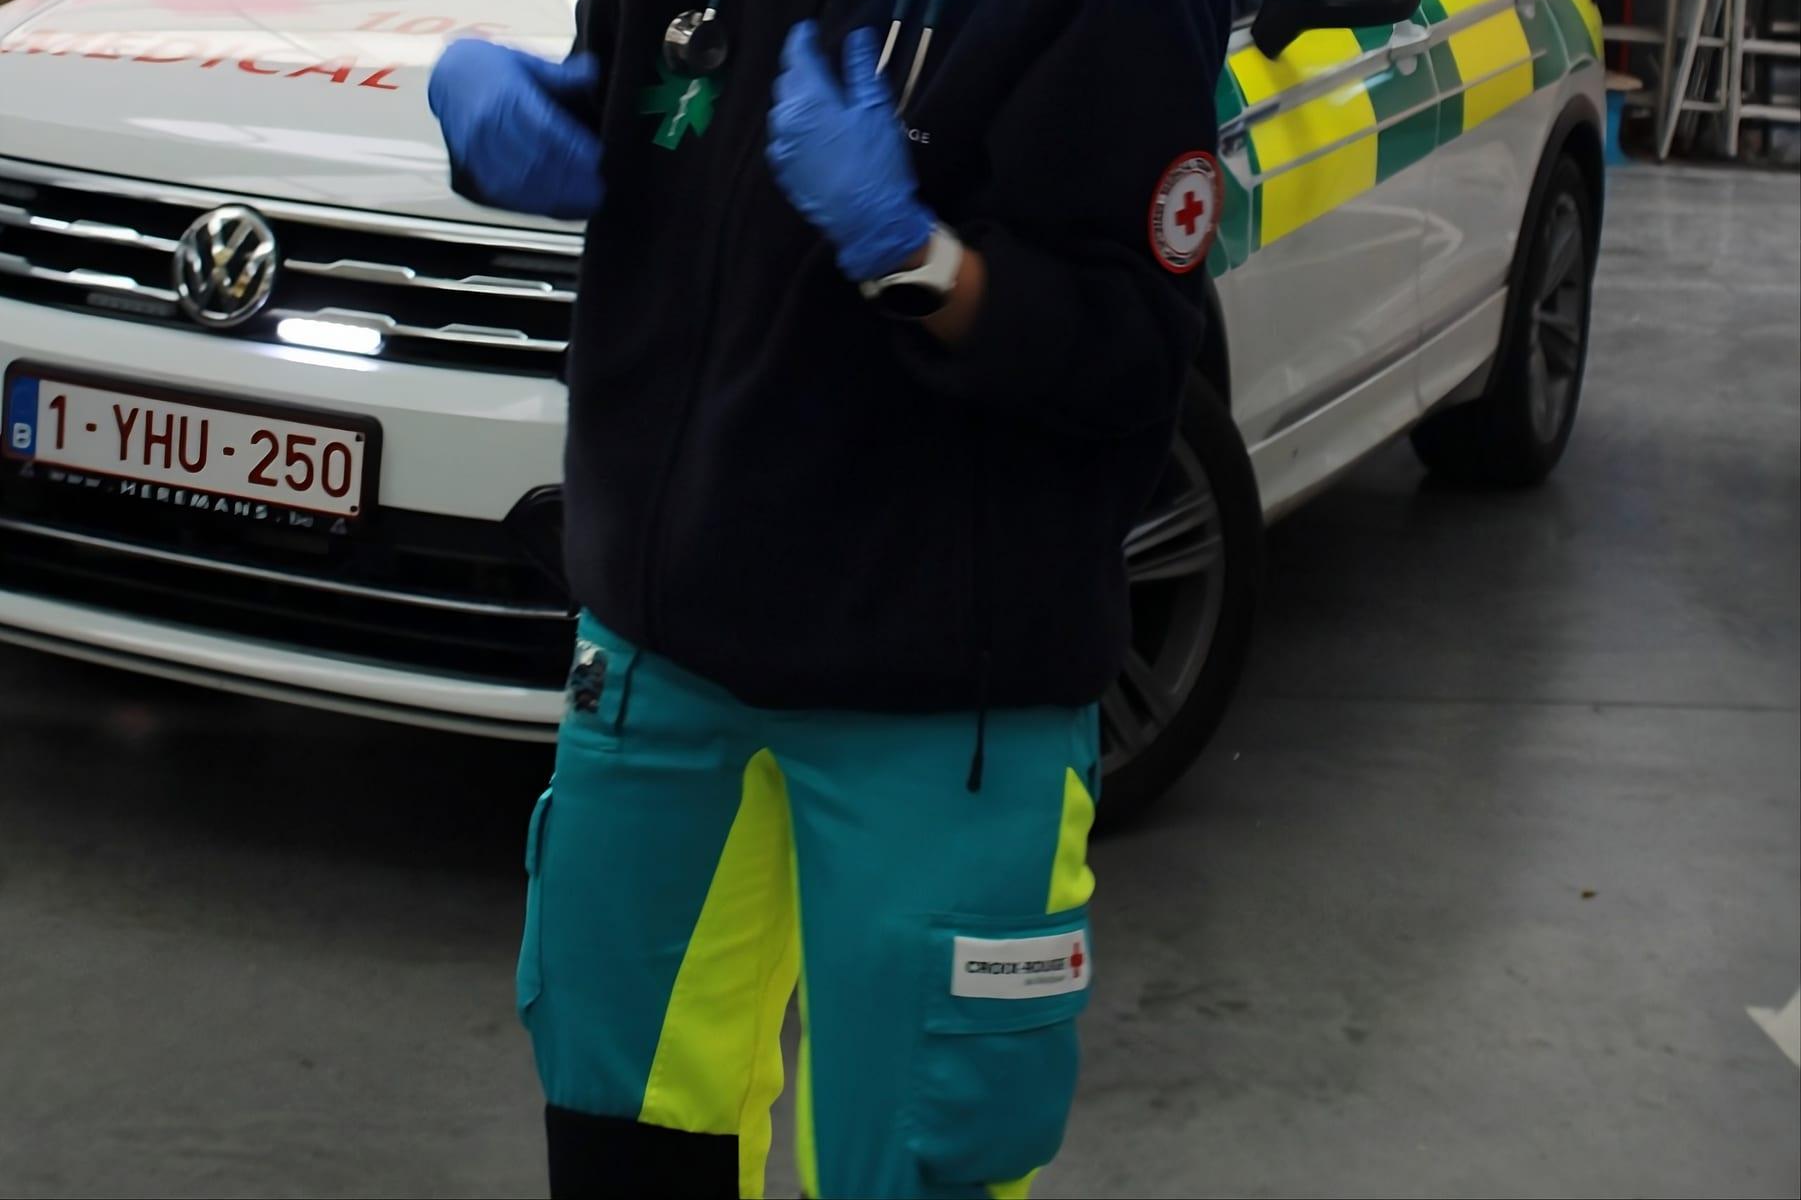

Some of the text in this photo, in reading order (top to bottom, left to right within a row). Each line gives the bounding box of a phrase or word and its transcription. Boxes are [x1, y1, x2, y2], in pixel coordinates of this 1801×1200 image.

[0, 29, 403, 90] MEDICAL
[12, 394, 353, 498] B 1-YHU-250
